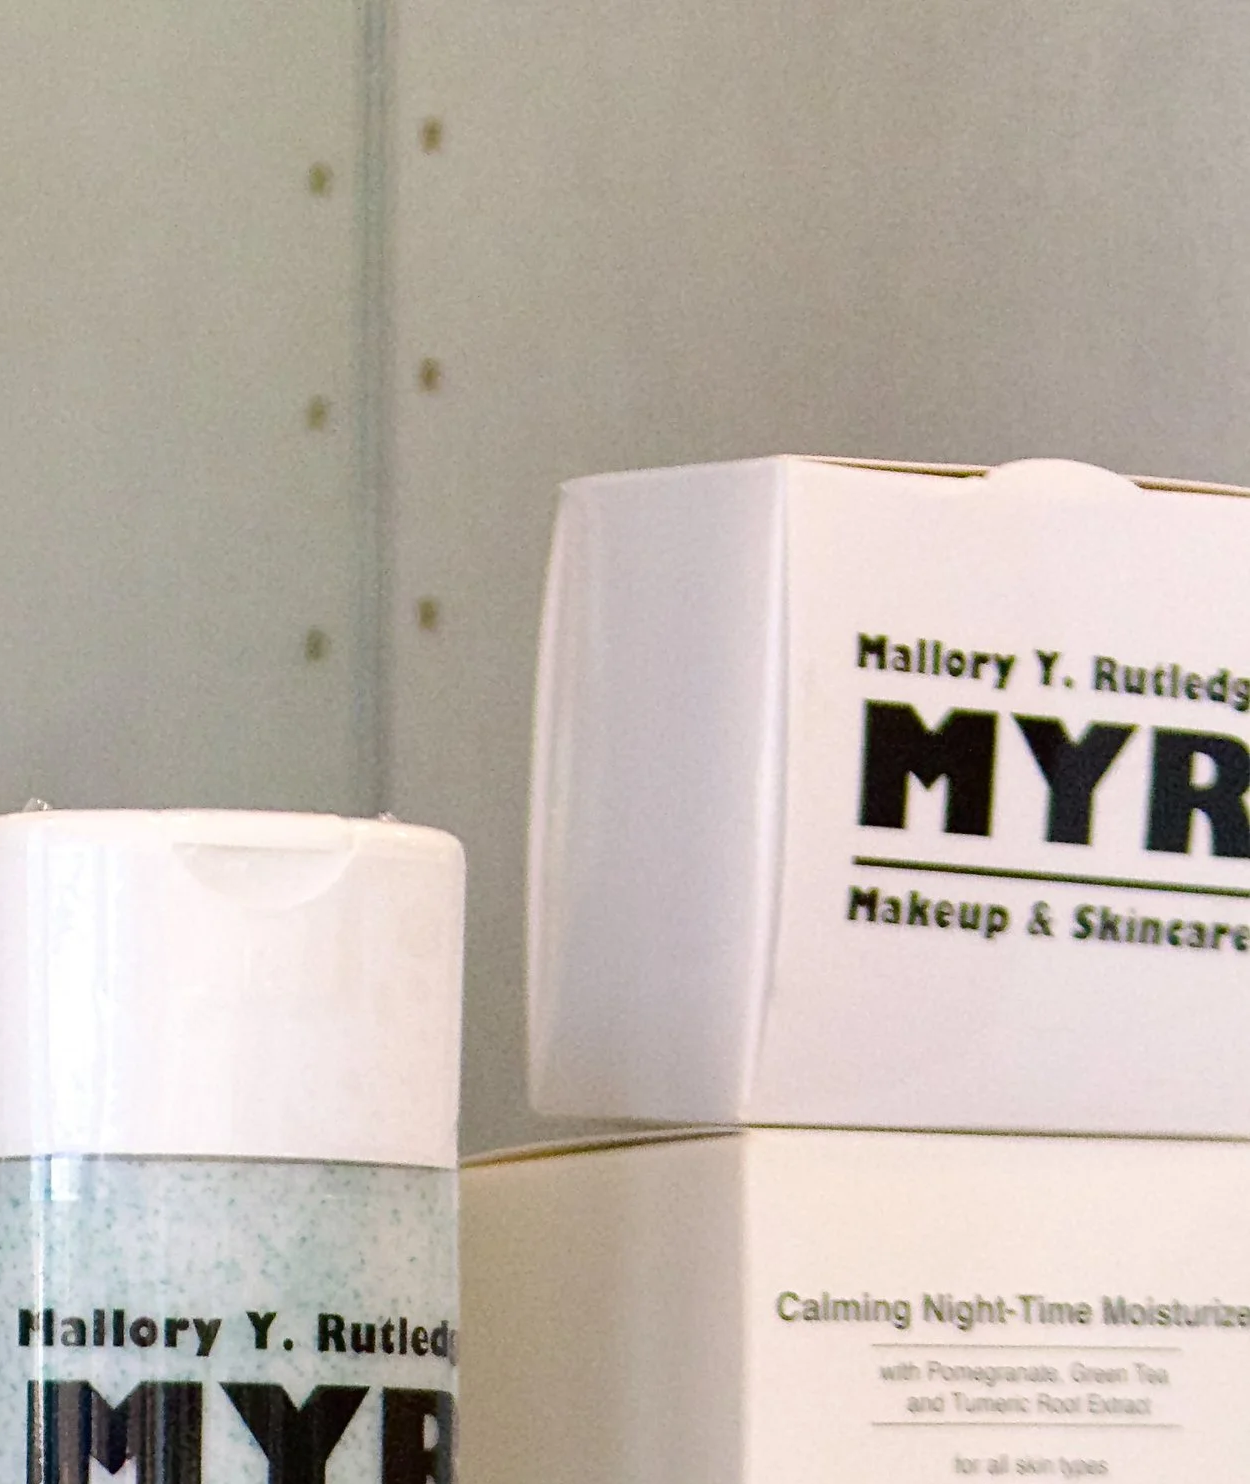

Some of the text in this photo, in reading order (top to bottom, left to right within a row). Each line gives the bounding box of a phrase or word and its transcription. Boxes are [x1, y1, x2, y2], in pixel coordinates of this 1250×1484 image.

[857, 633, 1016, 690] Mallory
[1035, 650, 1073, 688] Y.
[857, 698, 1250, 860] MYR
[846, 886, 1250, 953] Makeup & Skincare
[18, 1308, 222, 1358] Mallory
[246, 1311, 294, 1352] Y.
[775, 1291, 911, 1330] Calming
[922, 1293, 1093, 1331] Night-Time
